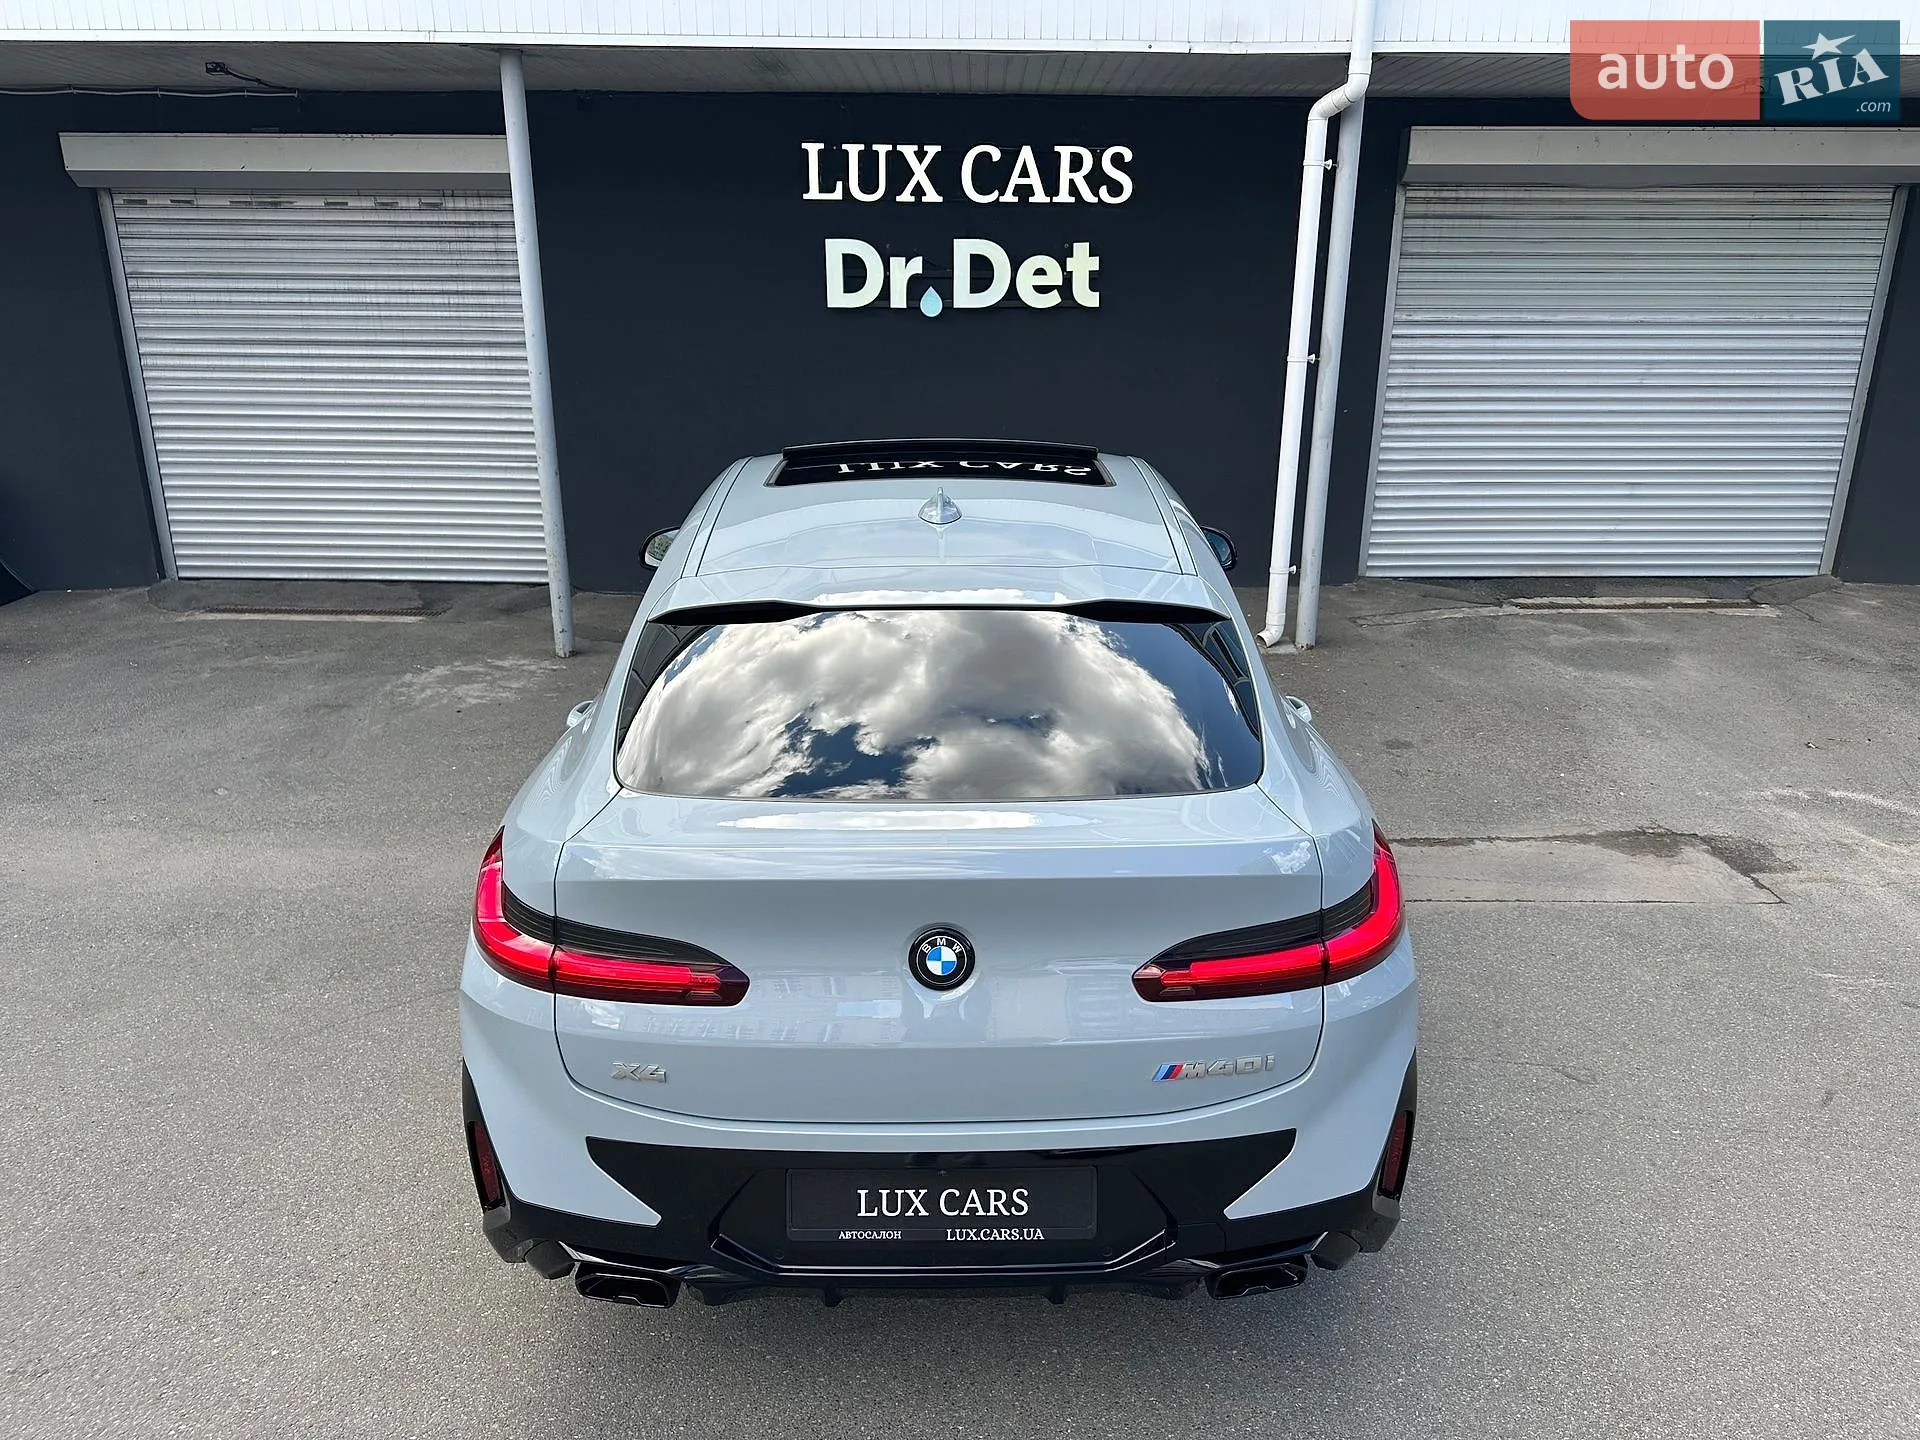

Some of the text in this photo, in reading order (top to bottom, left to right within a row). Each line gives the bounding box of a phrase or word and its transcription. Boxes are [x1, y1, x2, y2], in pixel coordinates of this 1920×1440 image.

[801, 142, 1134, 204] LUX CARS
[921, 937, 963, 954] BMW
[611, 1062, 667, 1083] X4
[1179, 1054, 1275, 1079] M40i
[856, 1188, 1030, 1217] LUX CARS
[838, 1230, 902, 1240] АВТОСАЛОН
[946, 1228, 1045, 1241] LUX.CARS.UA
